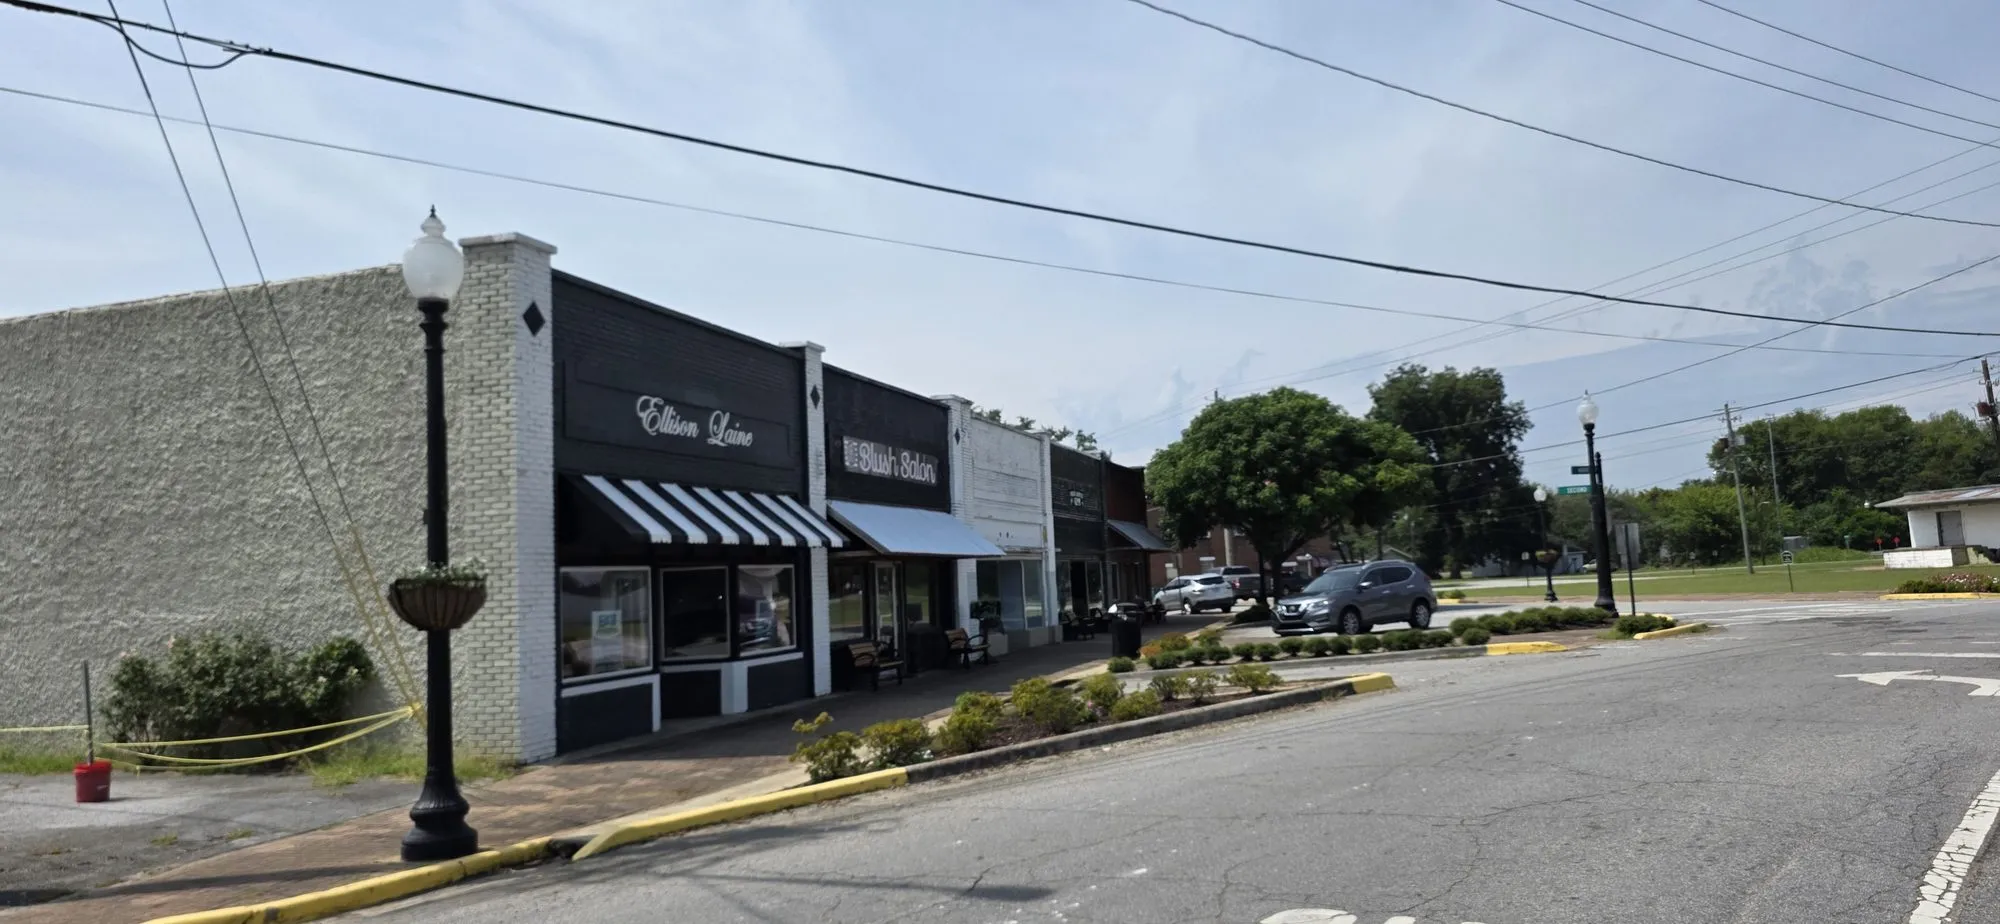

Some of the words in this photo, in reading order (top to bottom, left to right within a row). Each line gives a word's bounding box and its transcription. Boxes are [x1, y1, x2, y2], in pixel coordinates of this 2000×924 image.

[636, 395, 699, 436] Ellison
[706, 410, 753, 447] Laine
[860, 442, 899, 477] Blush
[901, 451, 936, 484] Salon
